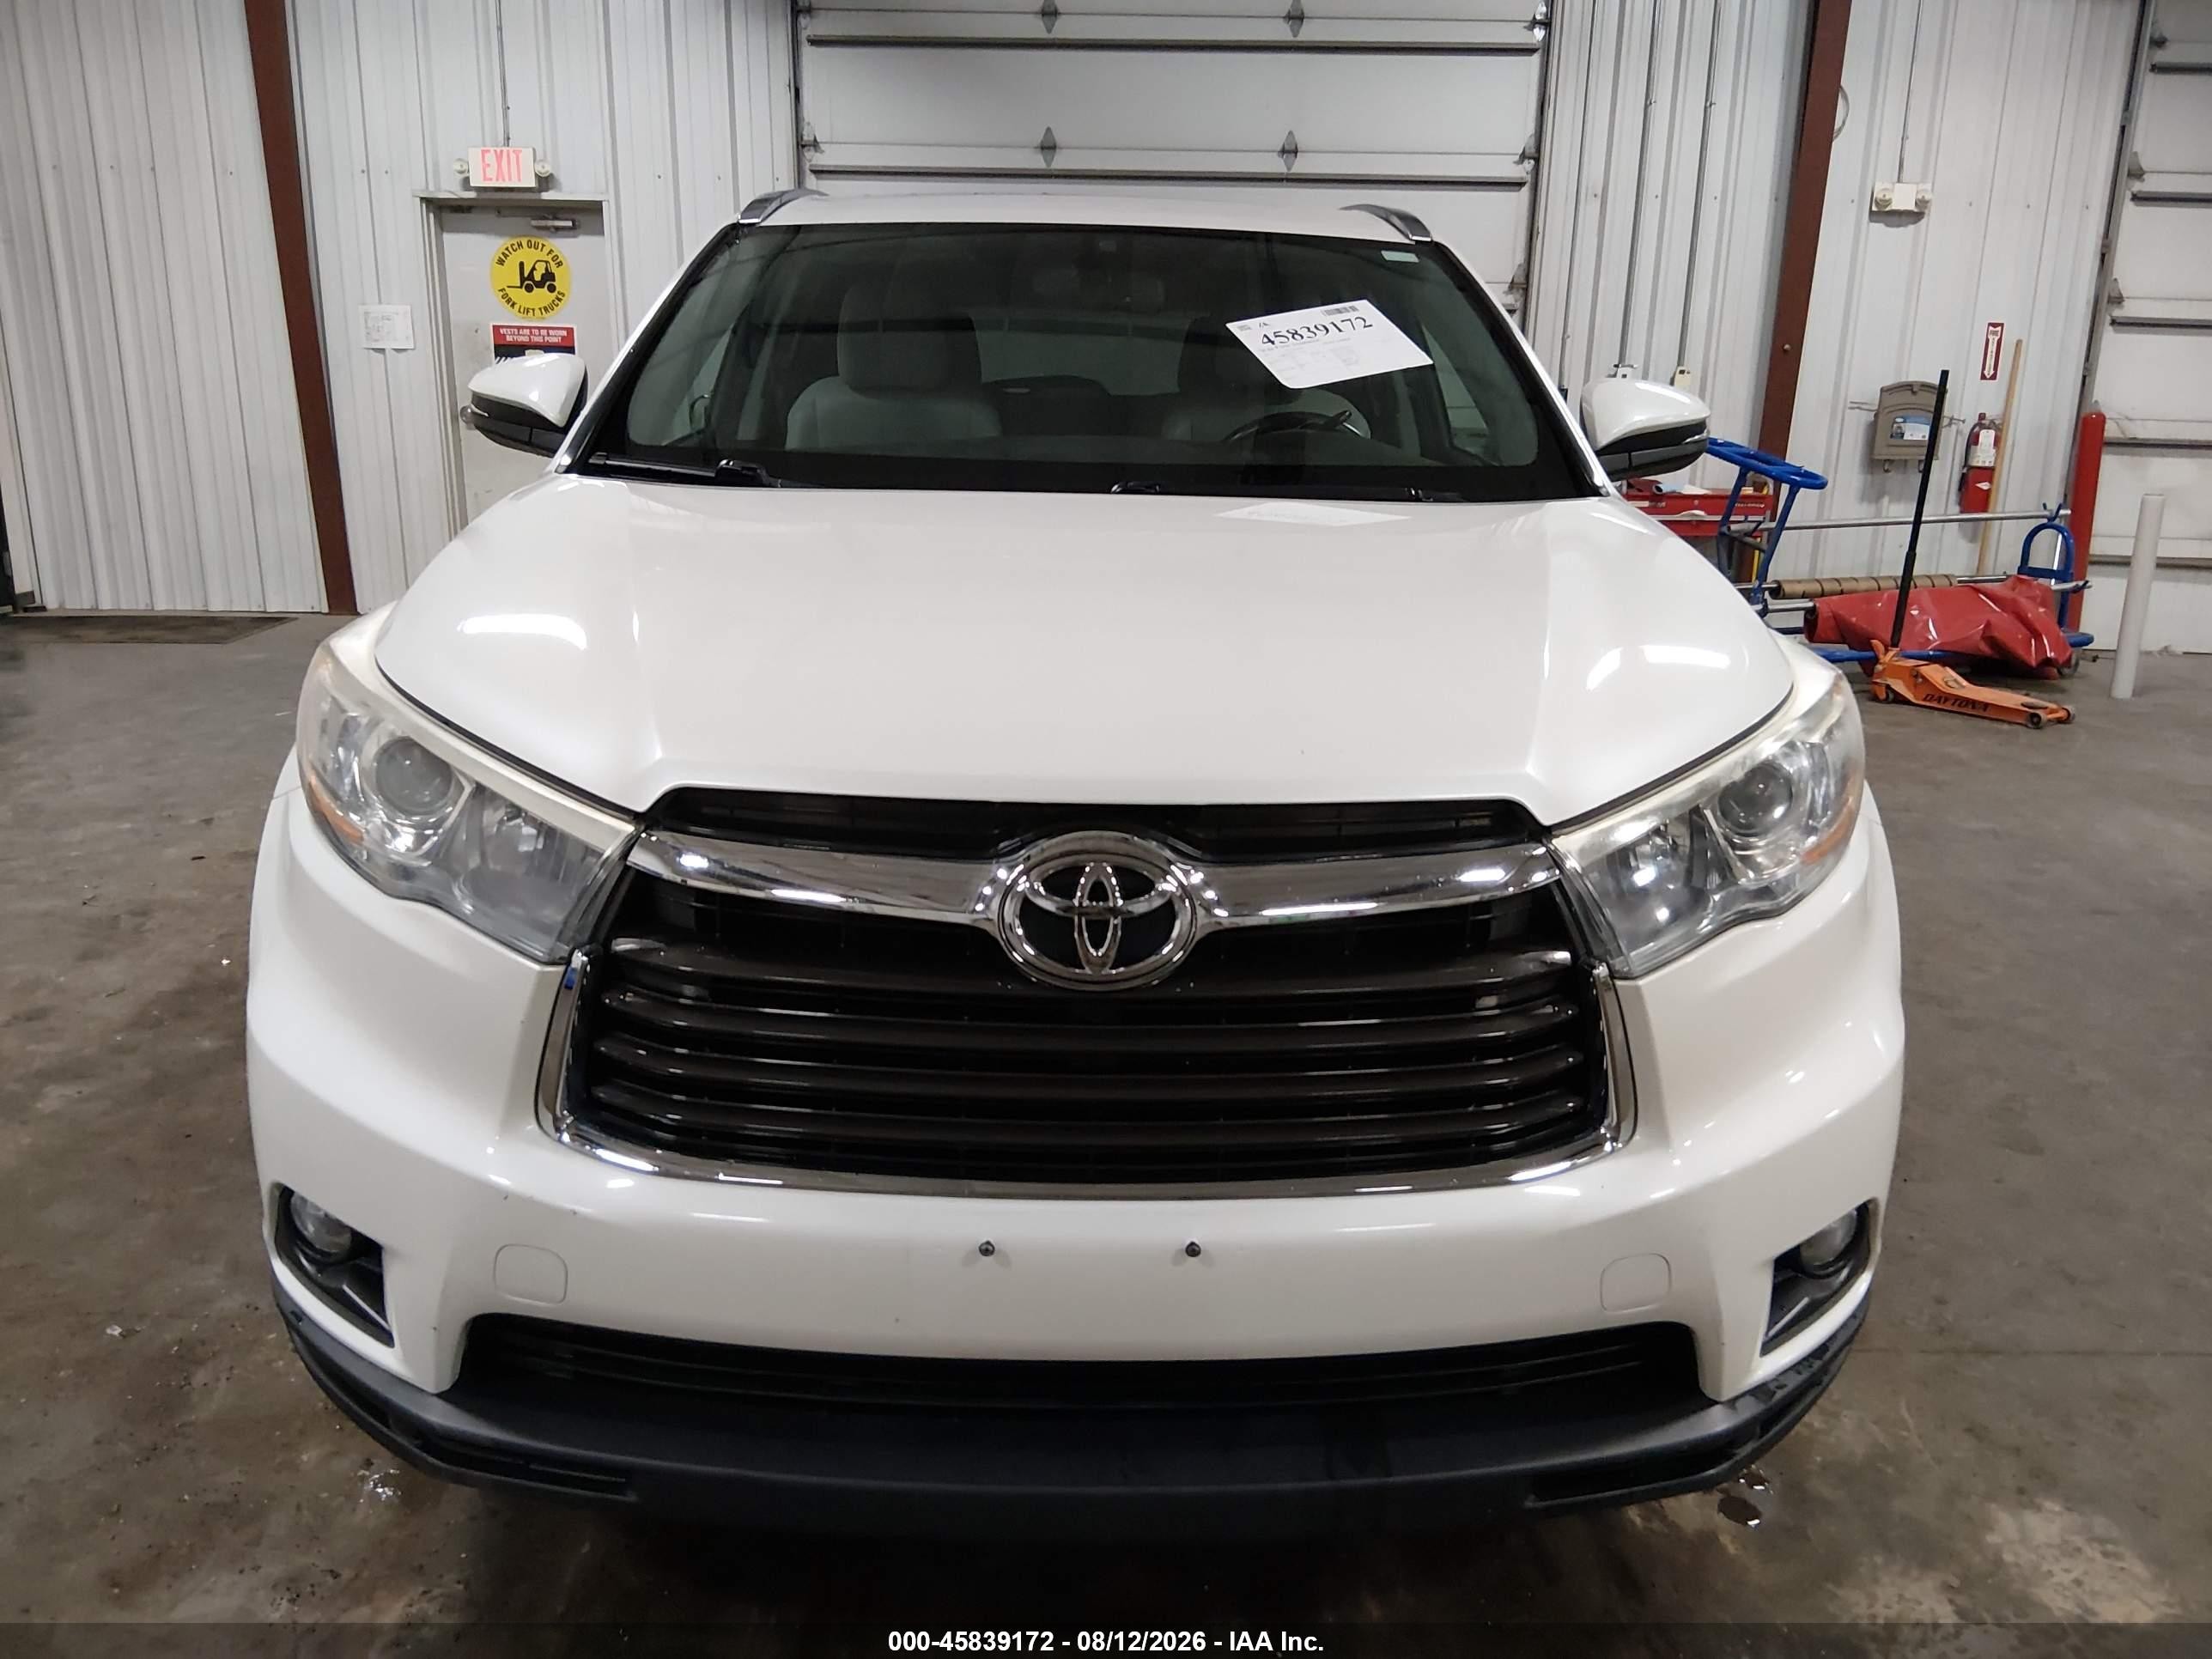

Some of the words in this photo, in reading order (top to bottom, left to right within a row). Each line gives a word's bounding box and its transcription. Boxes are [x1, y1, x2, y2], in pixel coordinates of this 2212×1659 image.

[481, 149, 522, 182] EXIT
[495, 240, 524, 266] WATCH
[526, 240, 546, 252] OUT
[546, 248, 563, 268] FOR
[498, 288, 517, 309] FORK
[518, 305, 536, 316] LIFT
[538, 290, 566, 316] TRUCKS
[1261, 316, 1373, 346] 45839172
